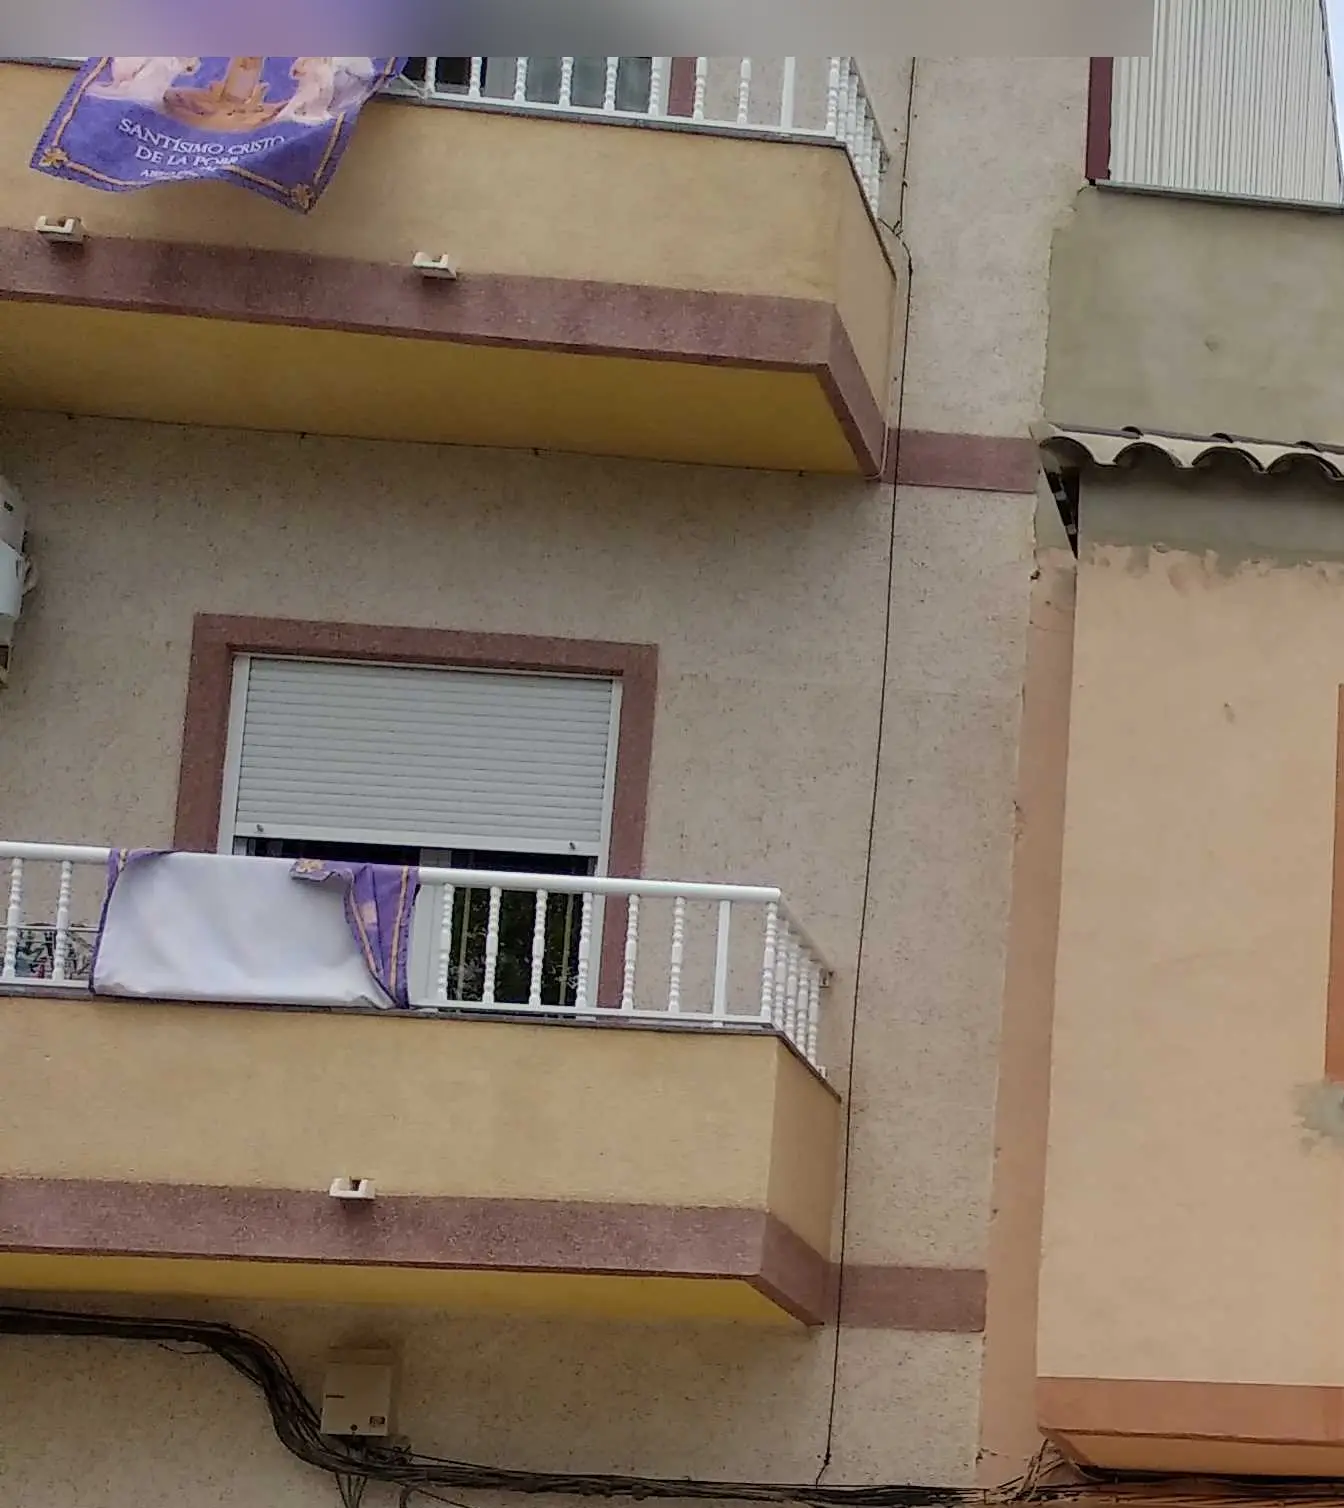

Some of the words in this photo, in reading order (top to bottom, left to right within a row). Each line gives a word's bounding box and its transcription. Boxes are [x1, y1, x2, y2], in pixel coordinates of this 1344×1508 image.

[119, 118, 223, 155] SANTÍSIMO
[227, 135, 285, 155] CRISTO
[135, 145, 164, 164] DE
[167, 155, 189, 166] LA
